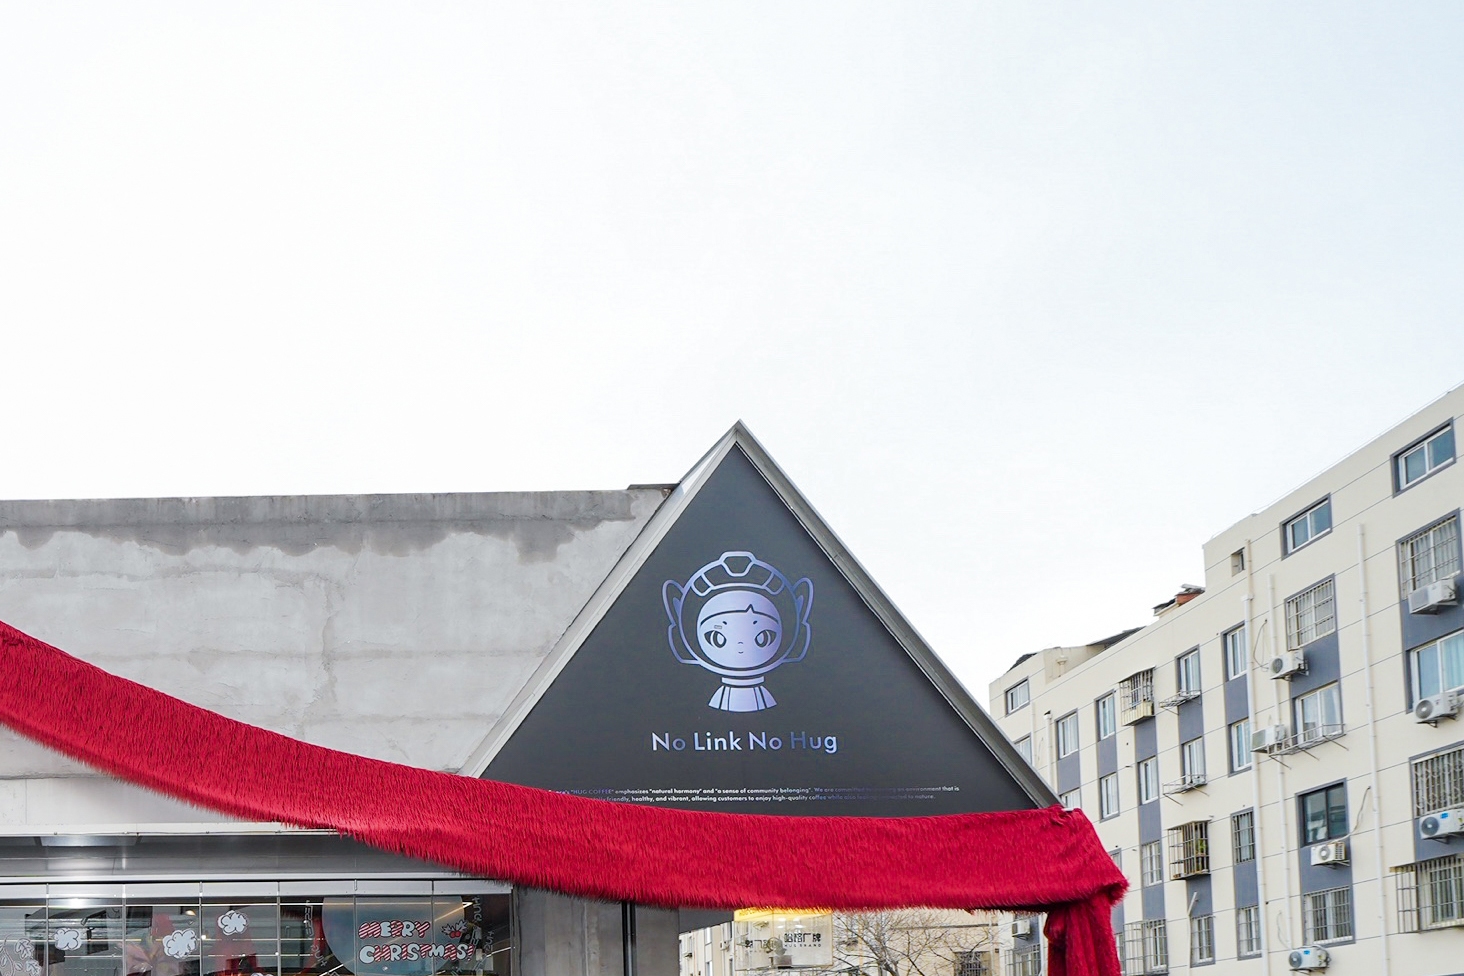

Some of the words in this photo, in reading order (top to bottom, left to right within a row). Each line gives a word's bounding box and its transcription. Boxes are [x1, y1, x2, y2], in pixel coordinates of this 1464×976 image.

[651, 731, 686, 751] No
[693, 731, 742, 751] Link
[748, 731, 783, 750] No
[790, 731, 837, 753] Hug
[615, 788, 648, 796] emphasizes
[747, 787, 779, 795] community
[772, 794, 808, 802] high-quality
[358, 920, 430, 939] MERRY
[359, 942, 476, 964] CHRISTMAS!
